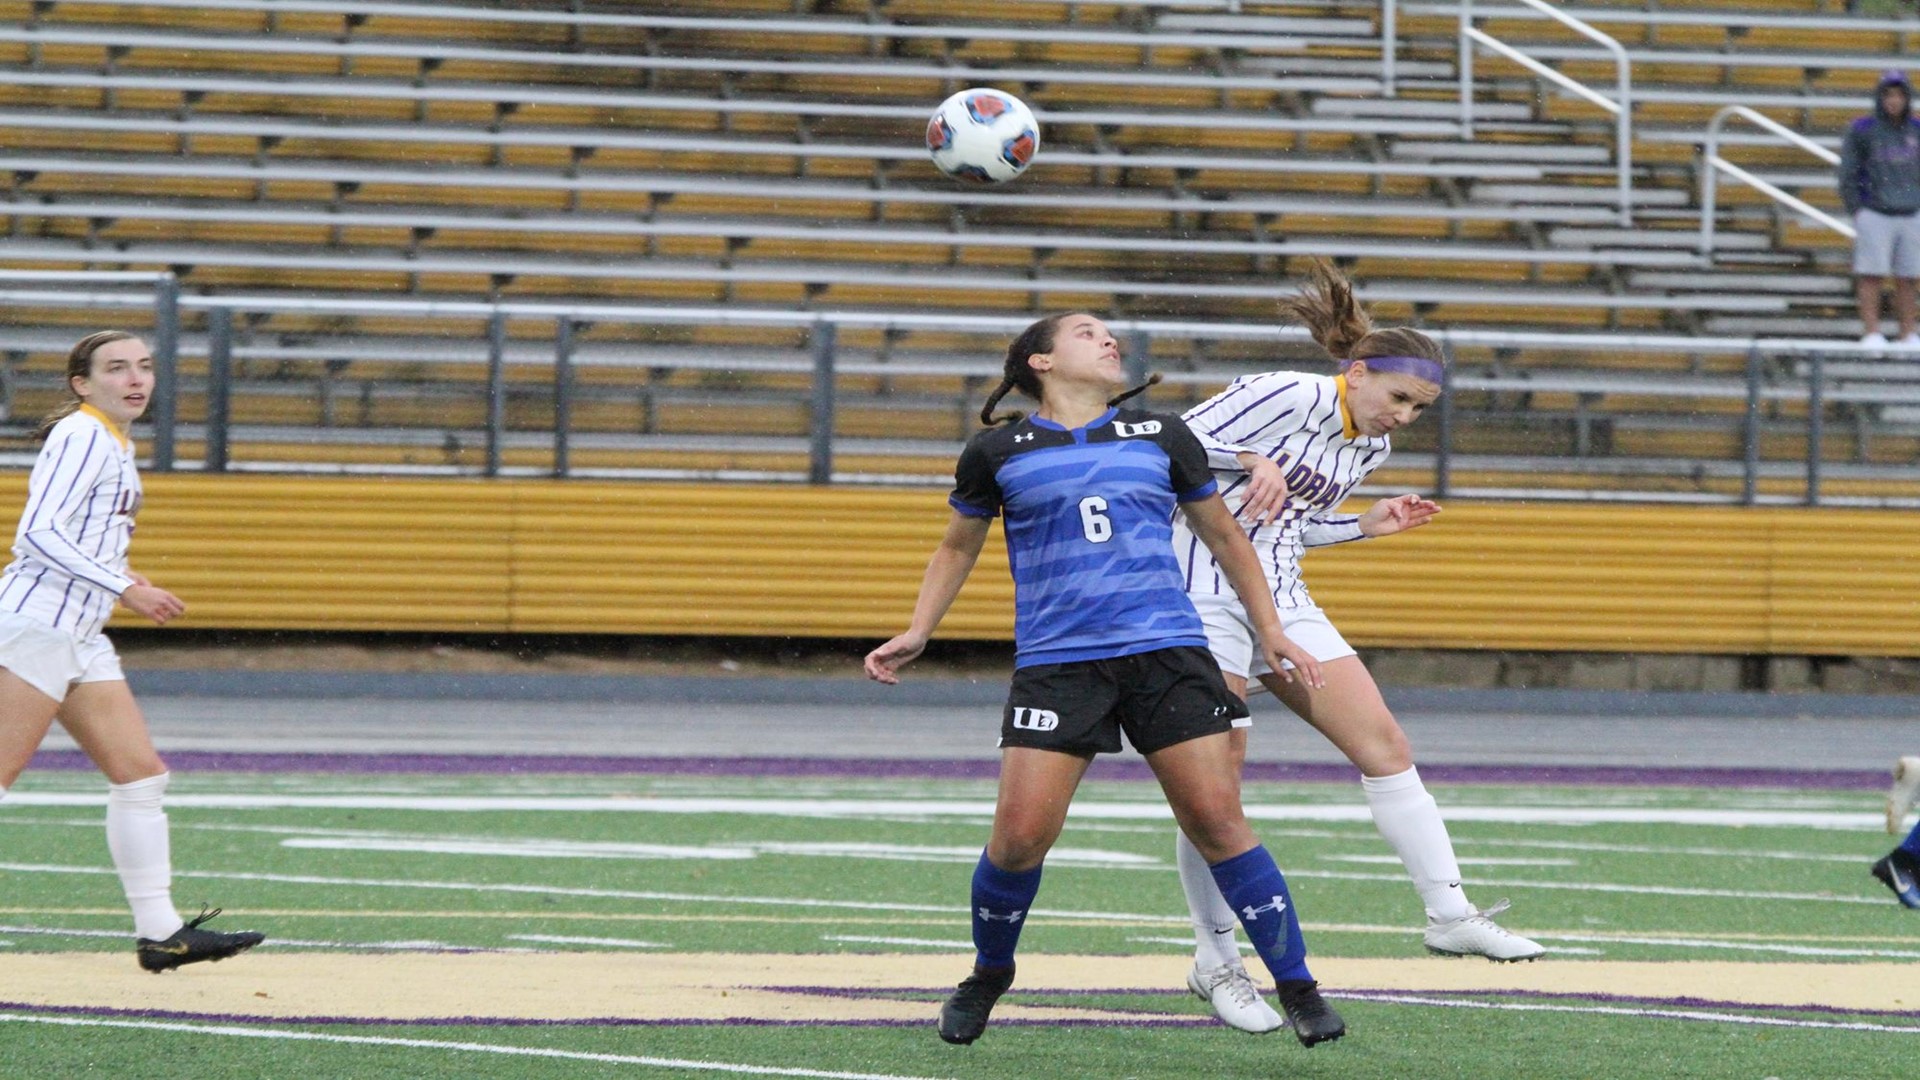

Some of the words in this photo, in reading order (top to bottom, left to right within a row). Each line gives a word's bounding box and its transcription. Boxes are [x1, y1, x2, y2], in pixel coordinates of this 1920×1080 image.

[1111, 420, 1162, 438] UD
[1078, 495, 1113, 544] 6
[1013, 706, 1059, 731] UD
